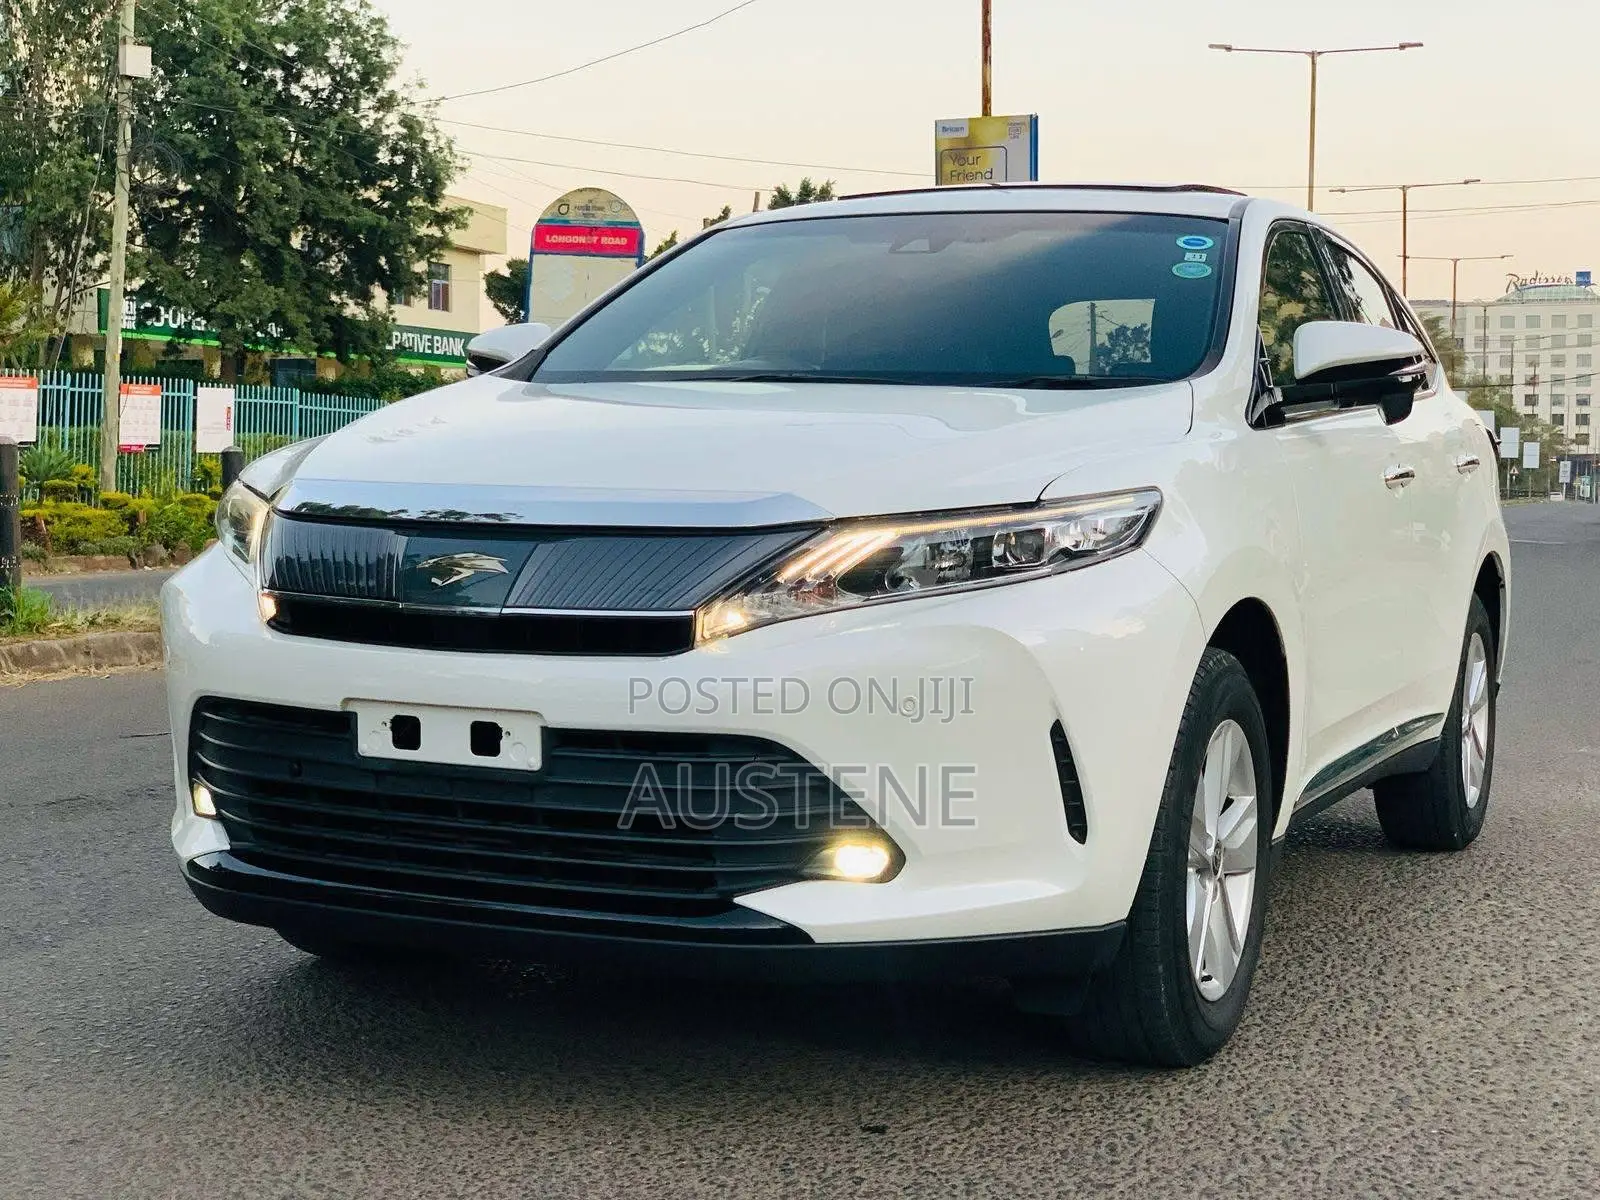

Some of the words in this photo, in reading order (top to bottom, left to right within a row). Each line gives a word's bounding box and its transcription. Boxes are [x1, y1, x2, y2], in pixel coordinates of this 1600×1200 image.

[949, 152, 981, 166] Your
[949, 168, 993, 182] Friend
[545, 234, 599, 244] LONGONOT
[600, 236, 628, 245] ROAD
[1505, 270, 1573, 294] Radisson
[434, 335, 466, 357] BANK
